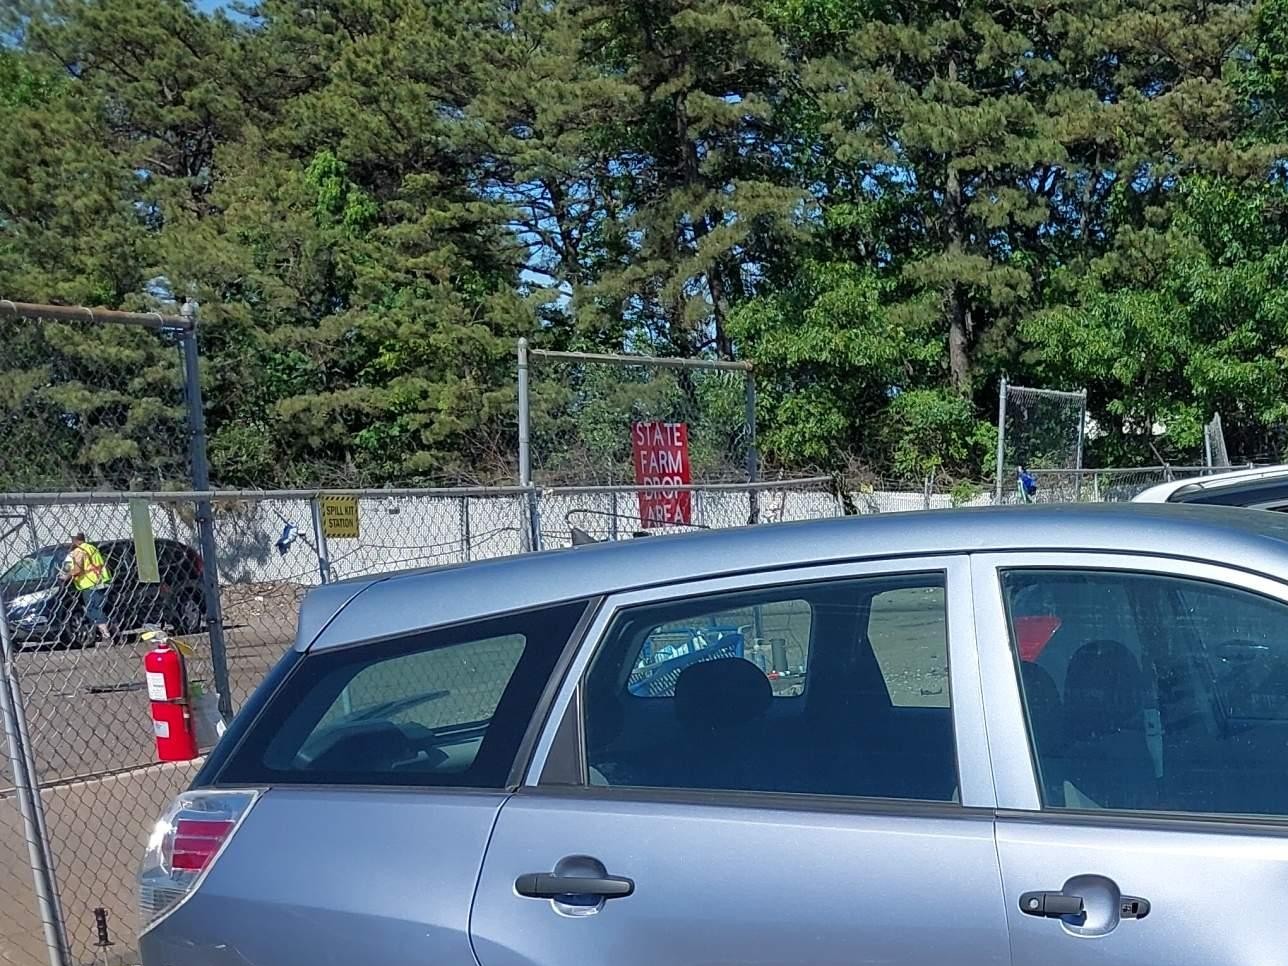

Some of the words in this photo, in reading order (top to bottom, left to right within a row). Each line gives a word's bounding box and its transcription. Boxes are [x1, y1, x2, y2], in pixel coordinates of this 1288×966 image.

[636, 422, 683, 446] STATE
[640, 450, 683, 473] FARM
[643, 476, 683, 500] DROP
[326, 506, 343, 515] SPILL
[345, 505, 354, 514] KIT
[647, 504, 684, 528] AREA
[328, 518, 353, 528] STATION
